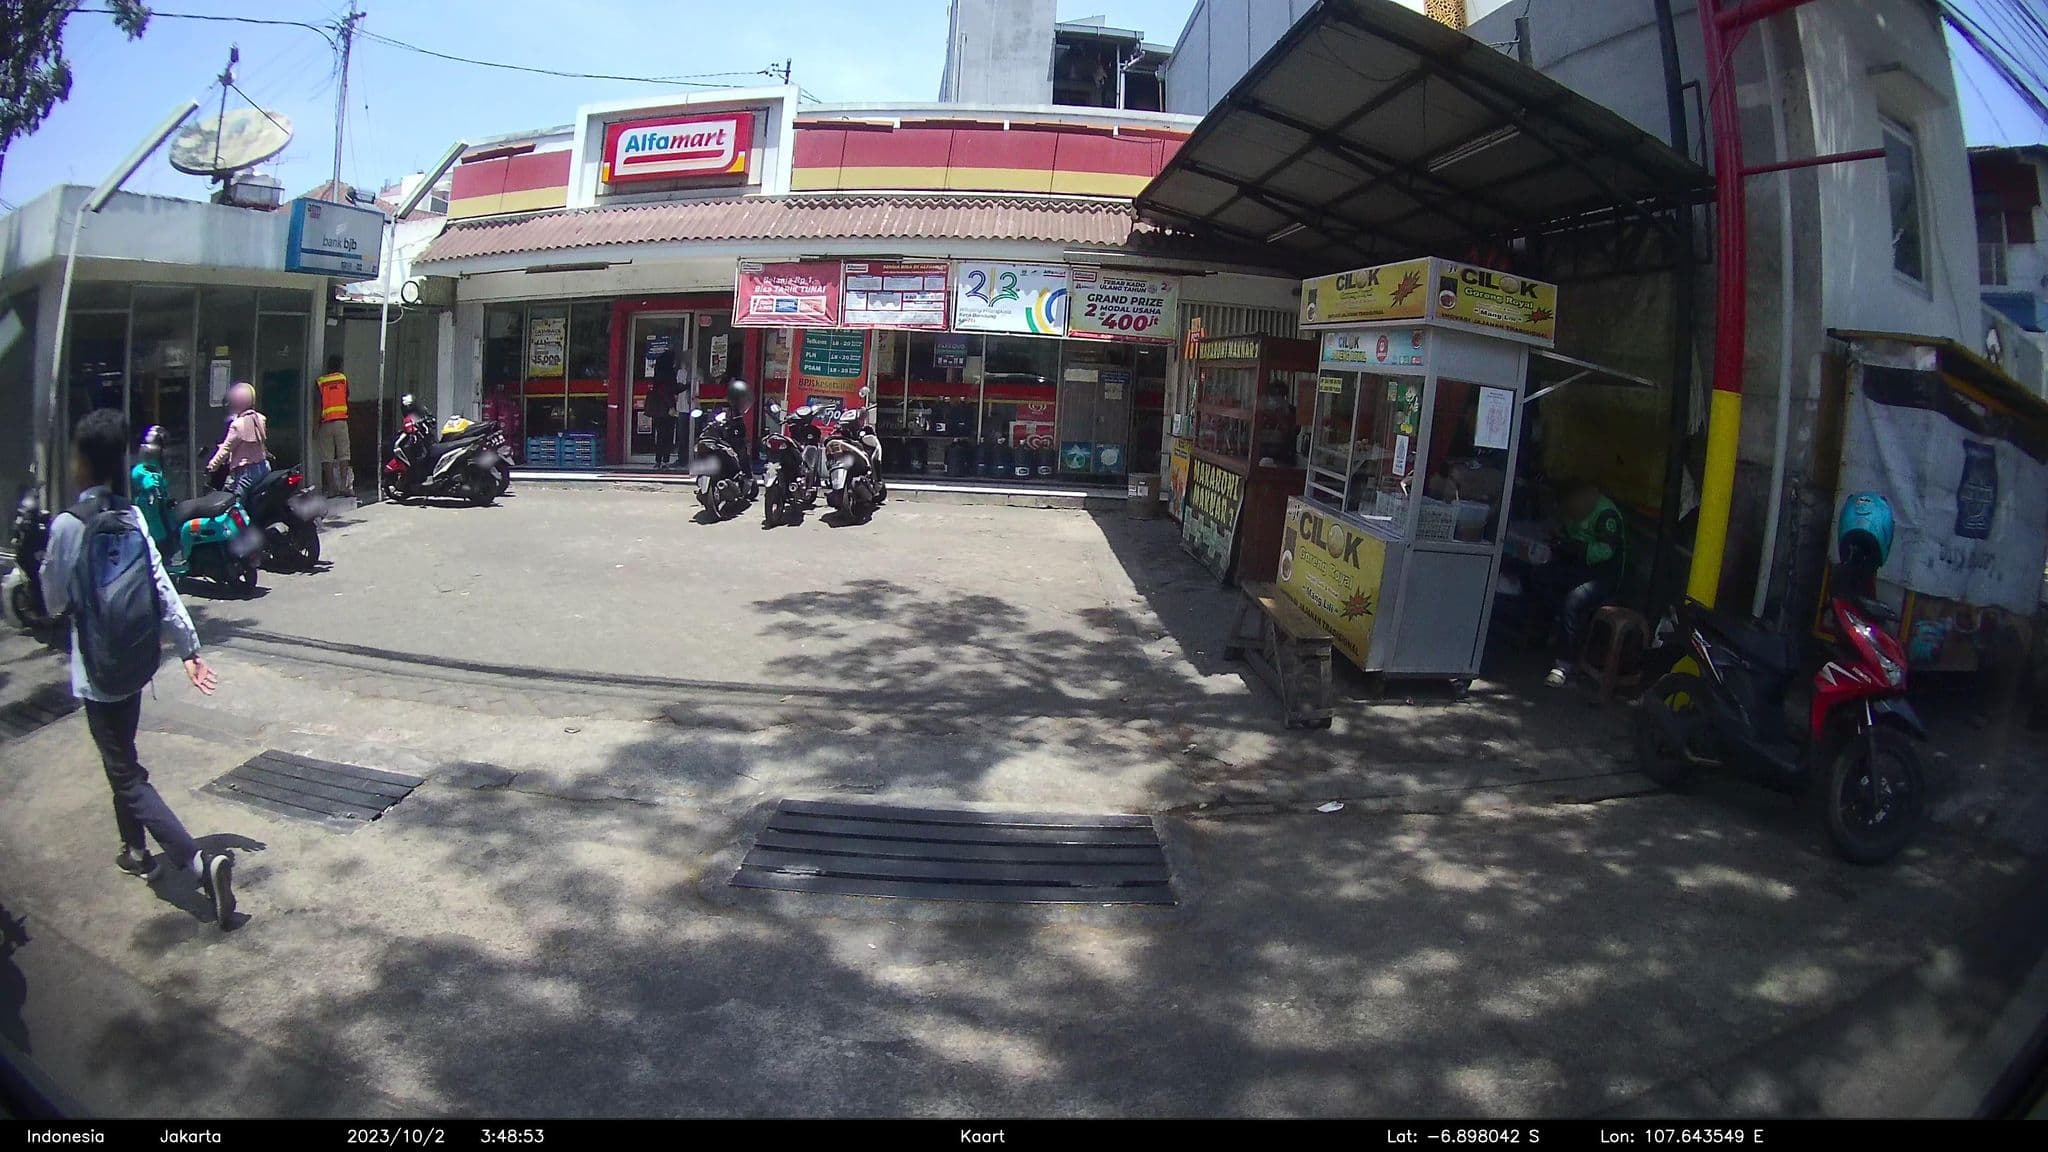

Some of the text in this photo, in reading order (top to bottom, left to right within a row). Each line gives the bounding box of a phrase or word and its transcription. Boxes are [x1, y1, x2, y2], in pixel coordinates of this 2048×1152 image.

[625, 128, 727, 153] Alfamart
[322, 234, 358, 251] bank bjb
[799, 285, 826, 293] TUNAI
[1126, 280, 1146, 288] KADO
[1336, 268, 1381, 291] CILOK
[1461, 267, 1538, 299] CILOK
[1087, 293, 1164, 307] GRAND PRIZE
[1464, 286, 1504, 304] Goreng
[1506, 296, 1534, 309] Royal
[1084, 303, 1098, 317] 2
[1100, 305, 1130, 313] MODAL
[1132, 307, 1161, 315] USAHA
[1480, 308, 1502, 320] Mang
[1338, 335, 1360, 350] CILOK
[1193, 458, 1242, 502] MAKARONI
[1300, 511, 1364, 570] CILOK
[1300, 545, 1327, 576] Goreng
[1330, 563, 1354, 590] Royal
